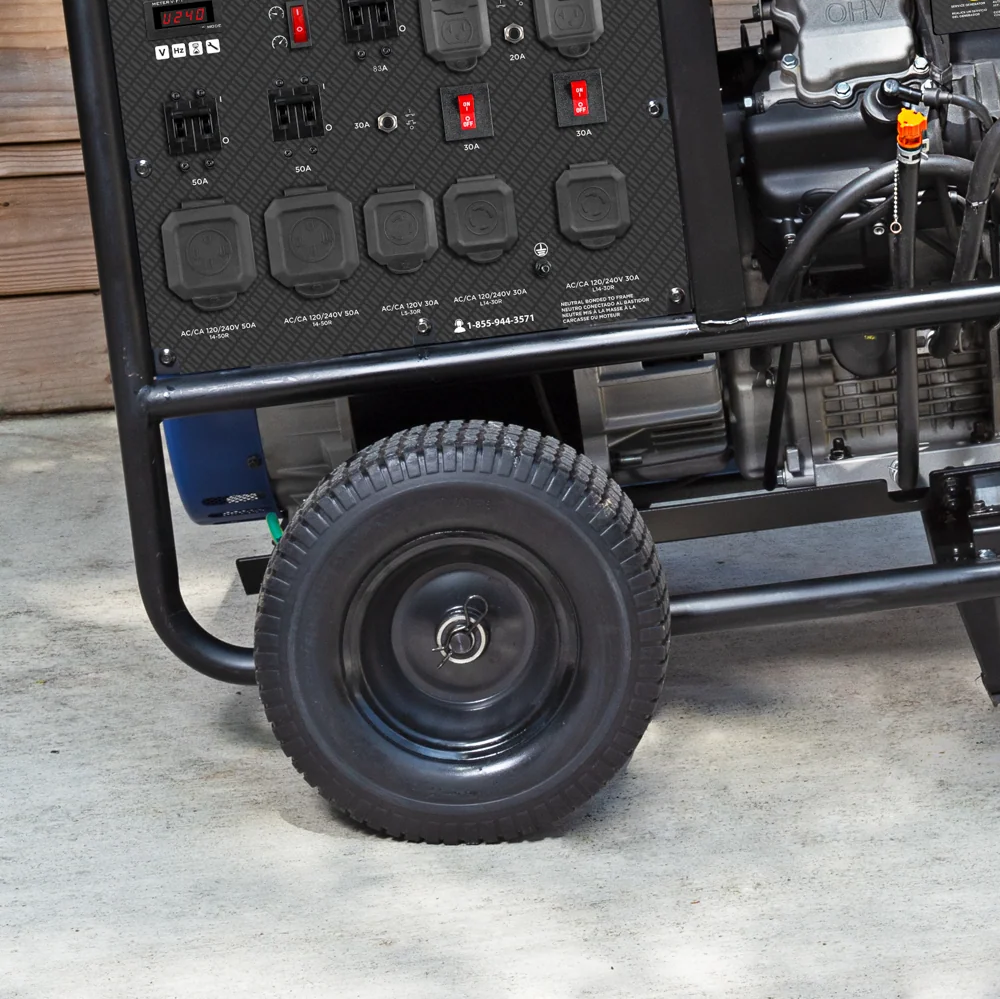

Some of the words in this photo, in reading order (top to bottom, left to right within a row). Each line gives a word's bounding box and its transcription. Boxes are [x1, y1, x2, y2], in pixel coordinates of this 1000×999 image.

[159, 48, 166, 57] V
[174, 47, 184, 55] Hz
[510, 53, 526, 61] 20A
[354, 121, 370, 130] 30A
[295, 164, 311, 173] 50A
[192, 178, 208, 186] 50A
[566, 281, 589, 289] AC/CA
[591, 276, 624, 286] 120/240V
[454, 295, 476, 303] AC/CA
[478, 290, 511, 300] 120/240V
[382, 303, 405, 312] AC/CA
[284, 316, 307, 324] AC/CA
[309, 311, 342, 320] 120/240V
[467, 314, 534, 329] 1-855-944-3571
[181, 328, 204, 337] AC/CA
[206, 324, 240, 333] 120/240V
